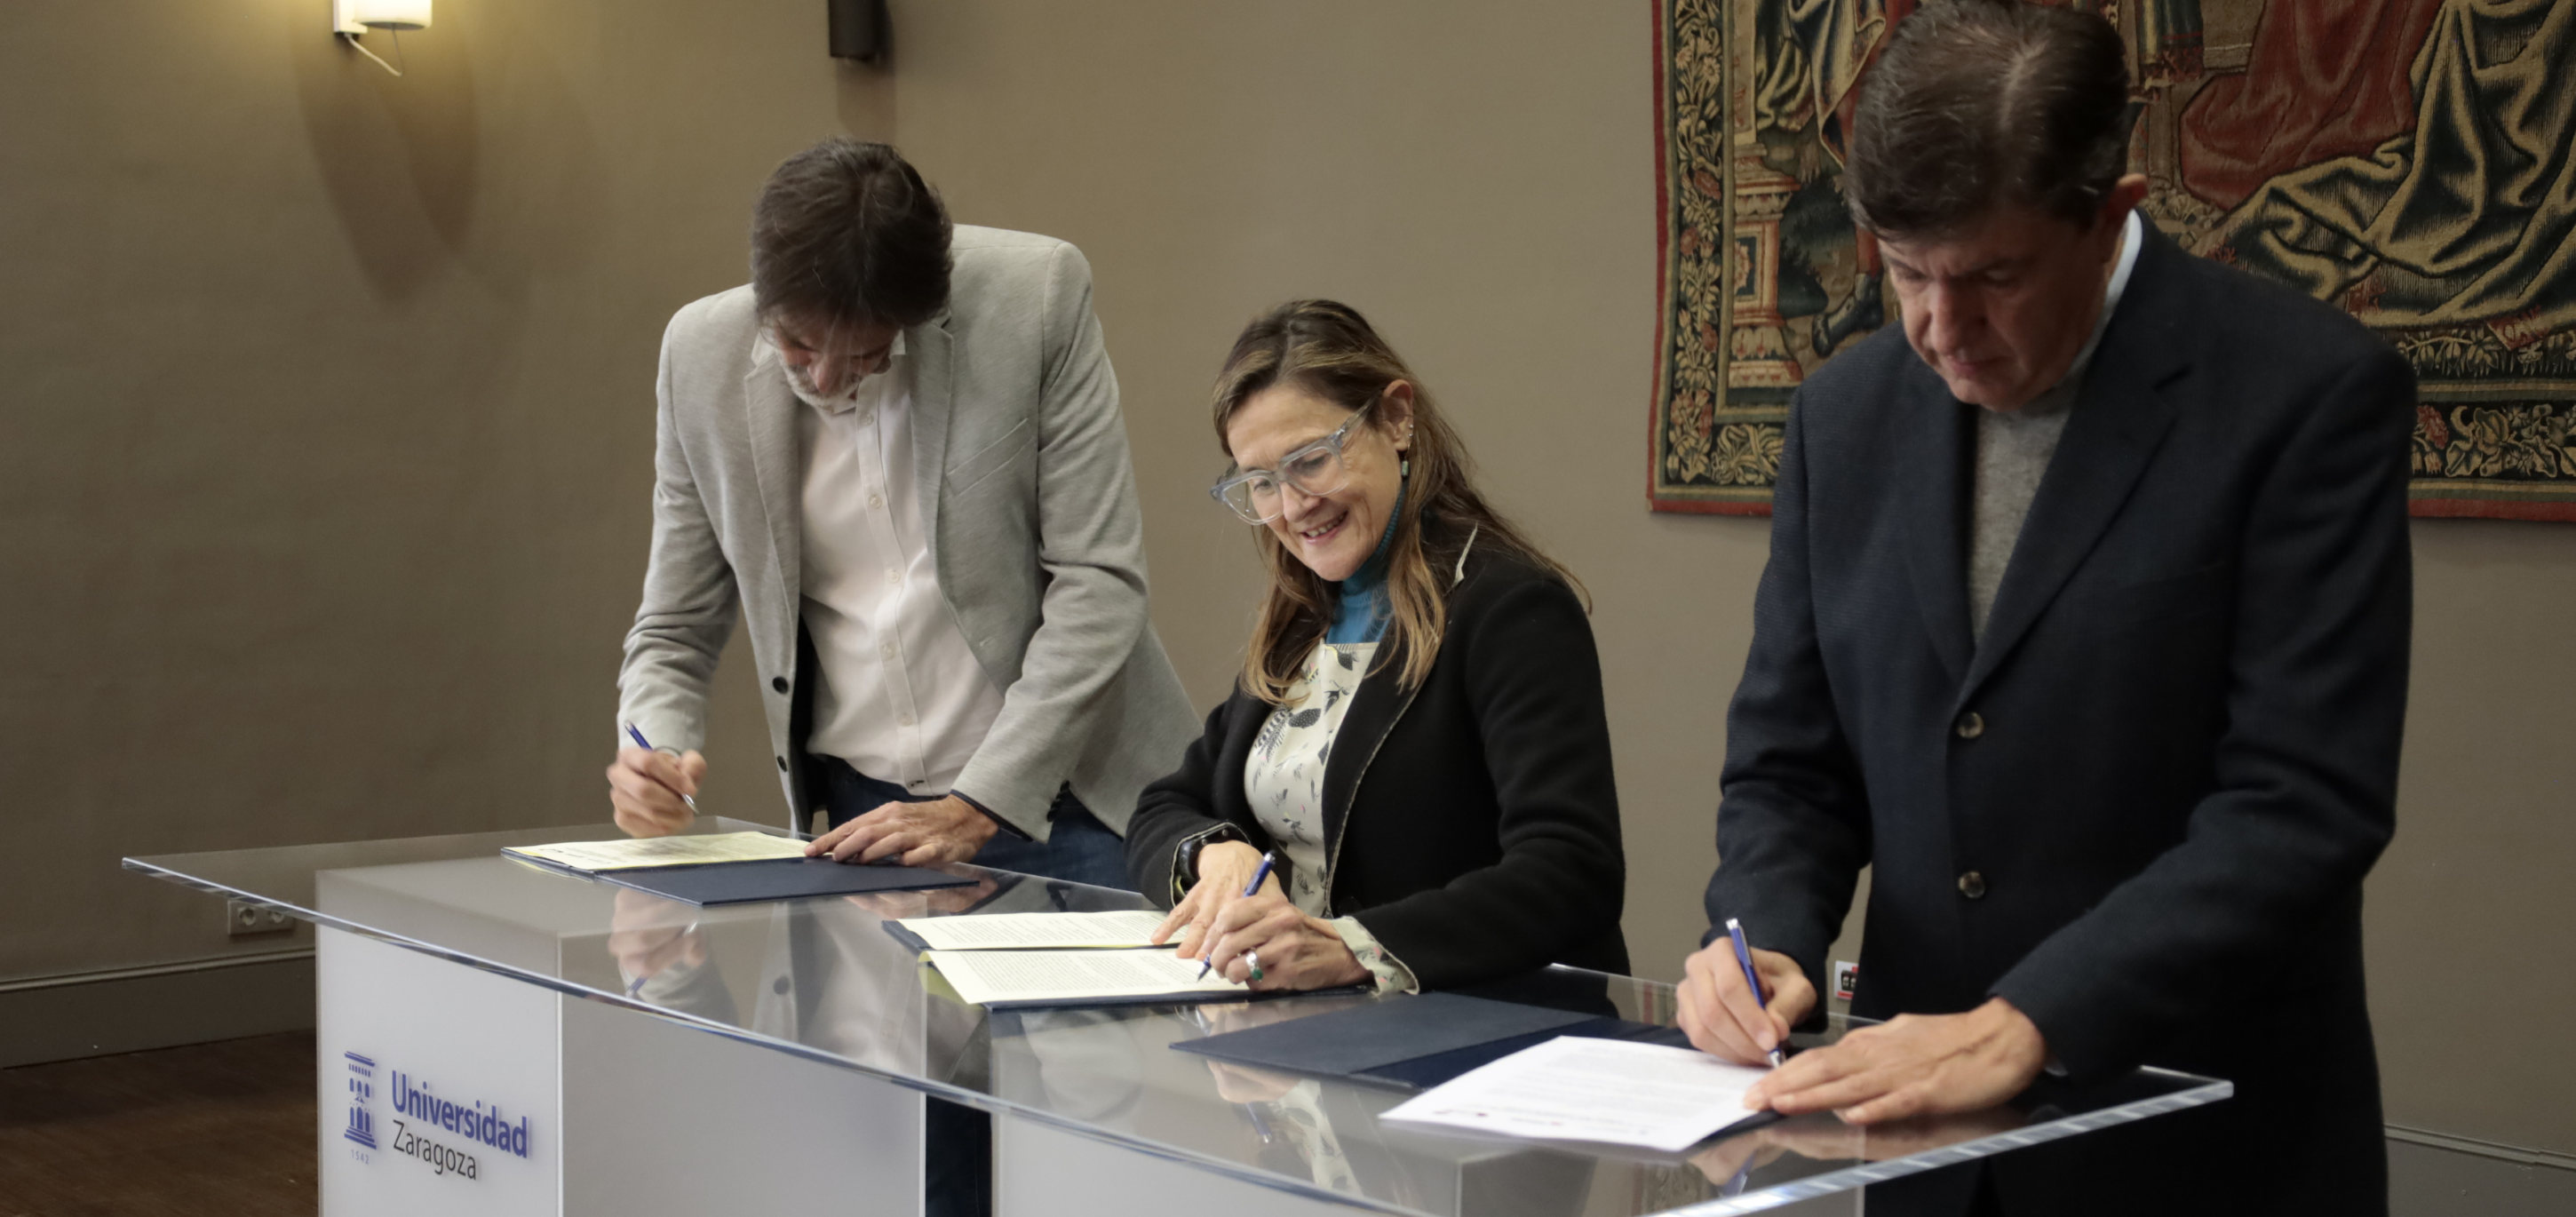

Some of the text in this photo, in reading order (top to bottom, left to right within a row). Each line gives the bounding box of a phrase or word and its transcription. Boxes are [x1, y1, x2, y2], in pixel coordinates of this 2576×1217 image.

[392, 1070, 527, 1158] Universidad
[351, 1149, 370, 1165] 1542
[393, 1119, 476, 1181] Zaragoza
